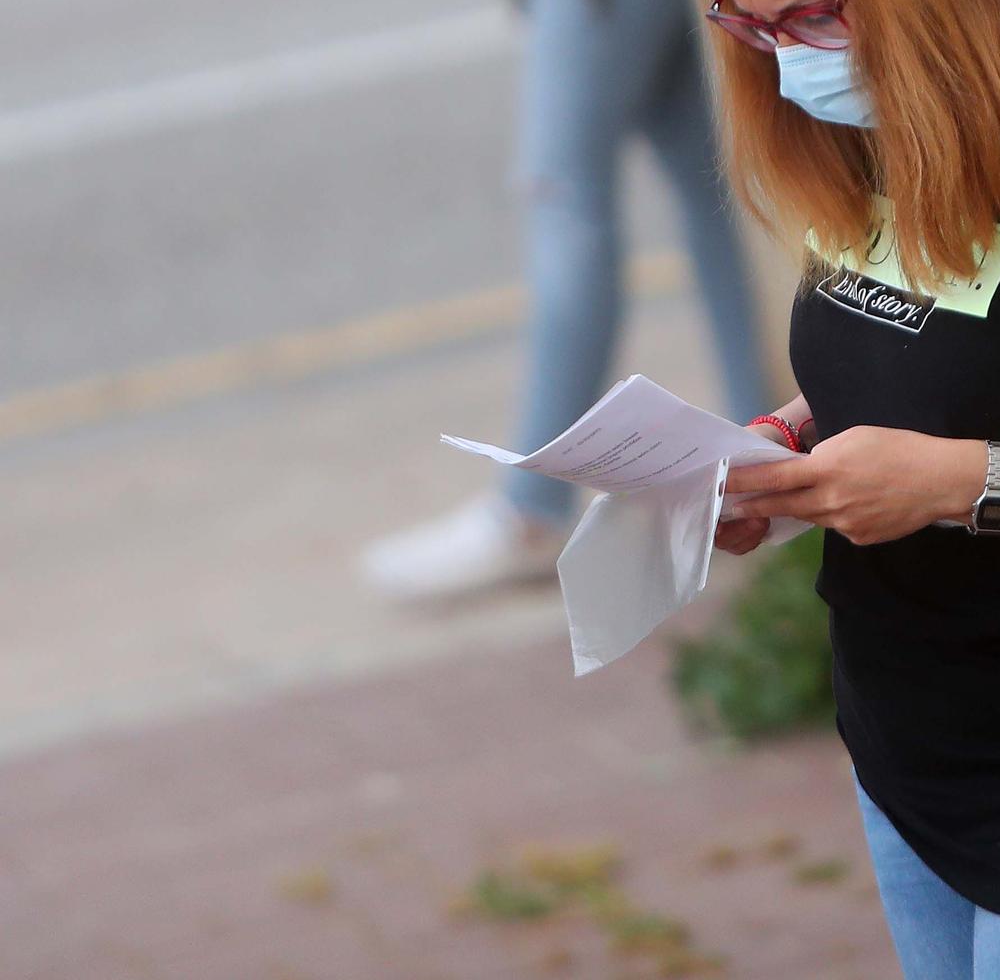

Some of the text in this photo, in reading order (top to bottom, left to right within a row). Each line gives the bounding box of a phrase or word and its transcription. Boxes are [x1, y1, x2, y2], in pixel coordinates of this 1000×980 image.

[832, 273, 922, 323] End of story.
